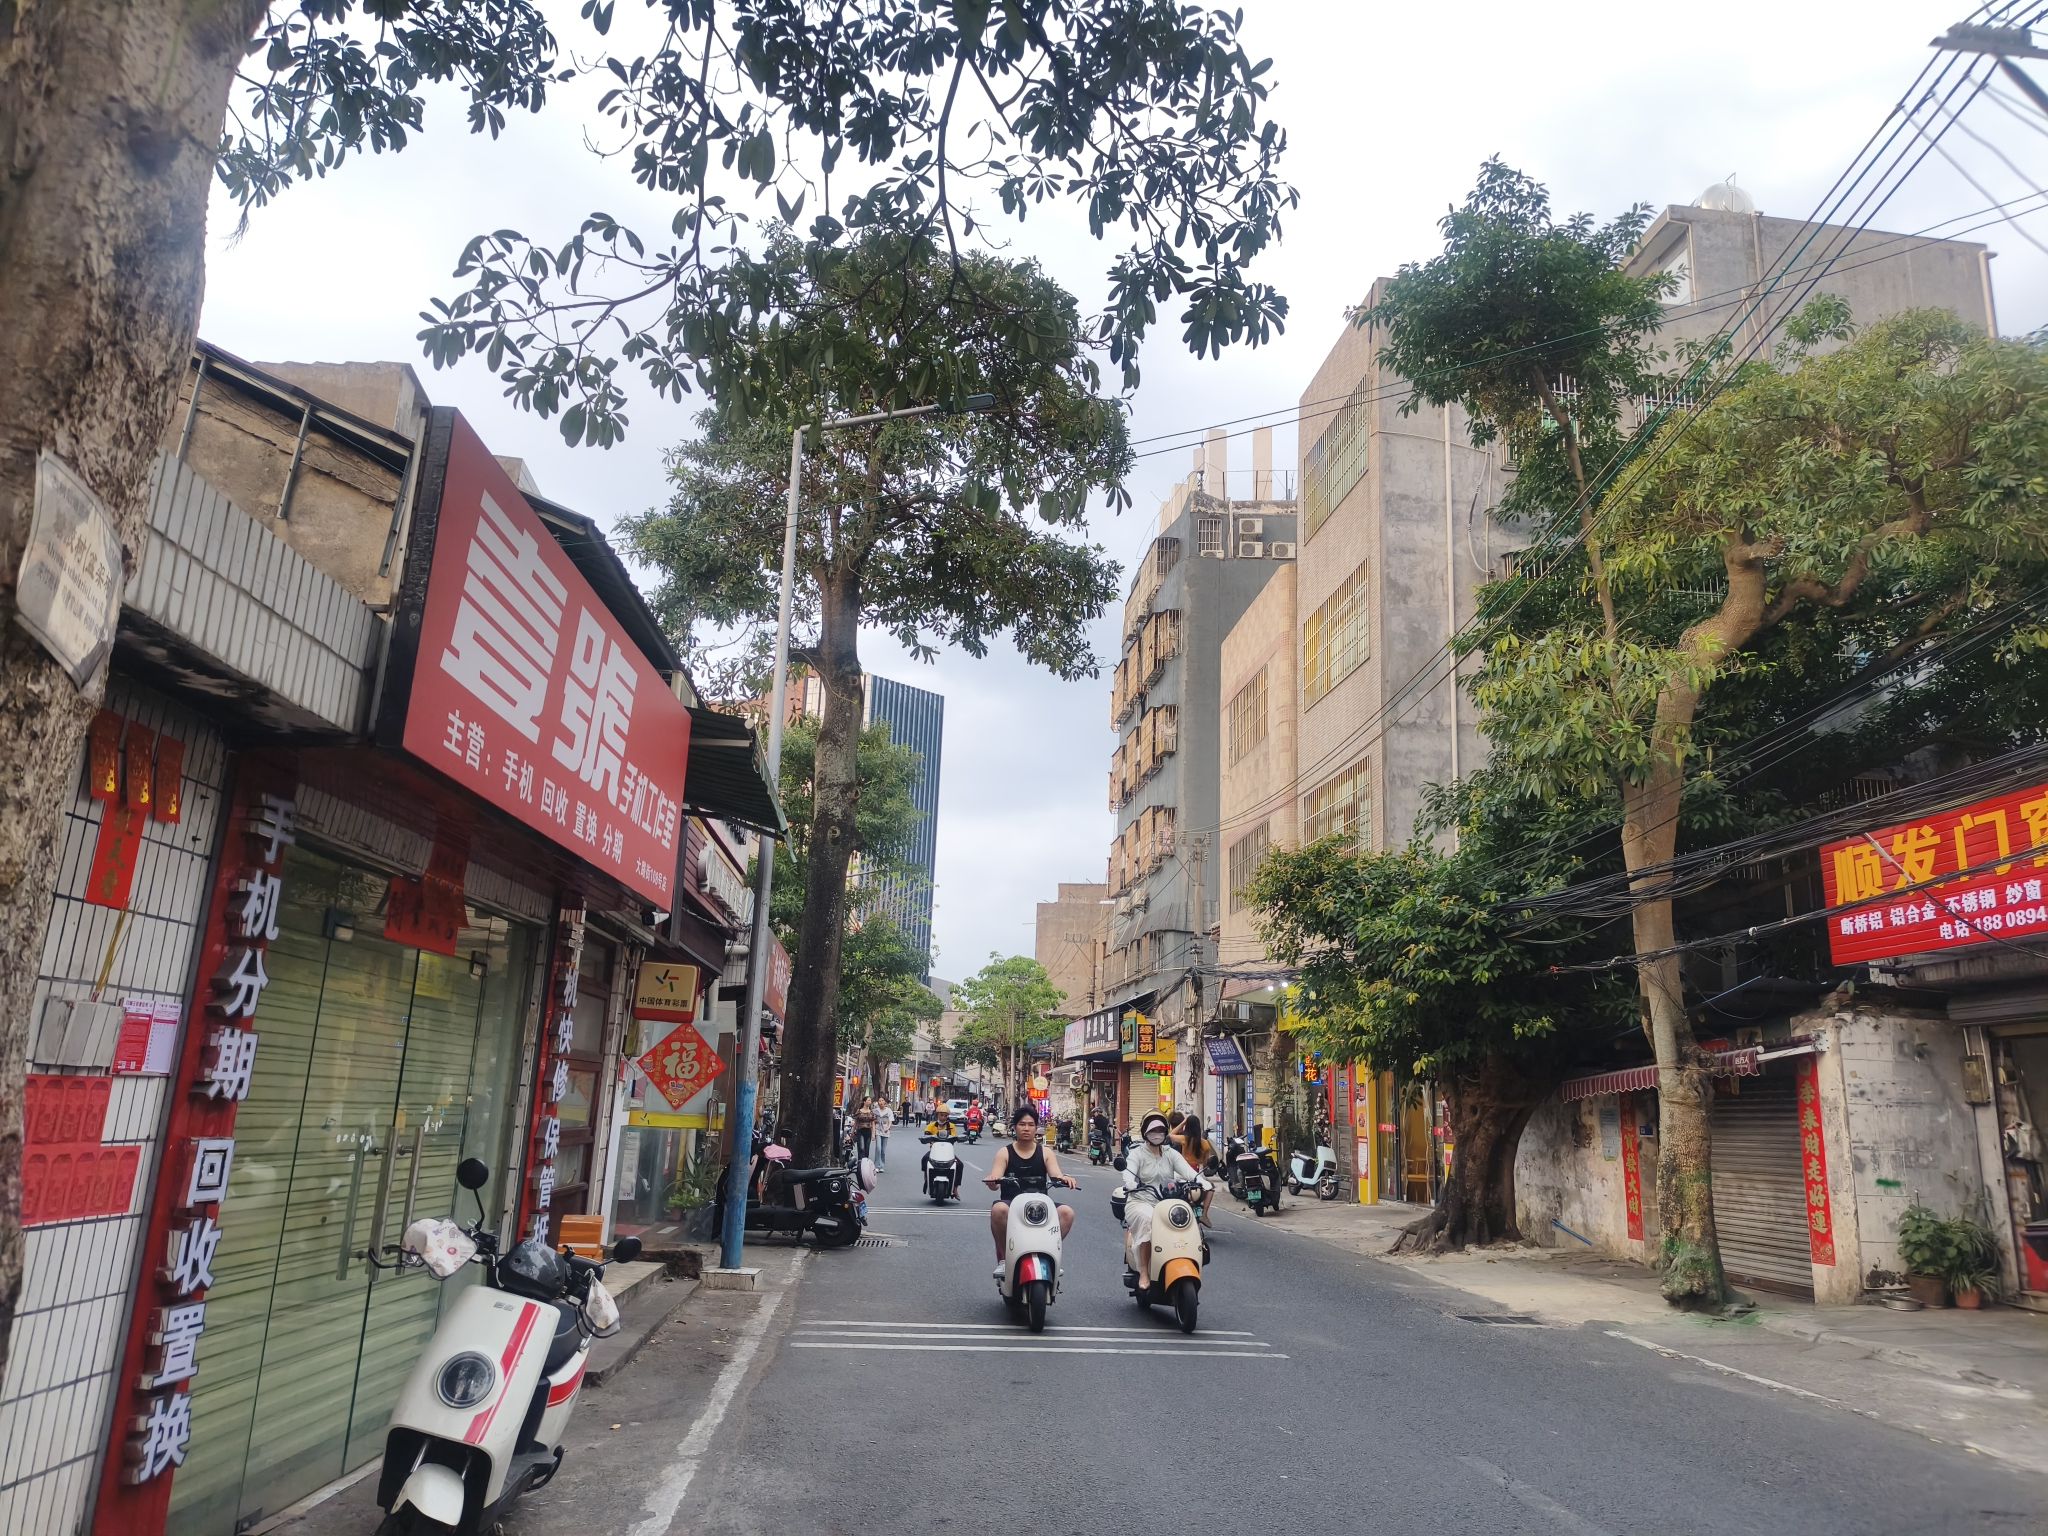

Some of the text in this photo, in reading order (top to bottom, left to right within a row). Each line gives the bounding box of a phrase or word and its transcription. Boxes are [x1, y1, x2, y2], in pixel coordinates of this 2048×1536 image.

[503, 749, 534, 804] 手机
[541, 777, 569, 827] 回收
[573, 801, 598, 846] 置换
[602, 823, 624, 864] 分期
[618, 761, 678, 850] 手机工作室
[1840, 879, 2042, 936] 断桥铝 铝合金 不锈钢 纱窗
[1939, 905, 2048, 940] 电话 188 0894
[662, 1041, 700, 1080] 福
[1139, 1025, 1153, 1053] 绿豆饼
[136, 793, 297, 1484] 手机分期回收置换
